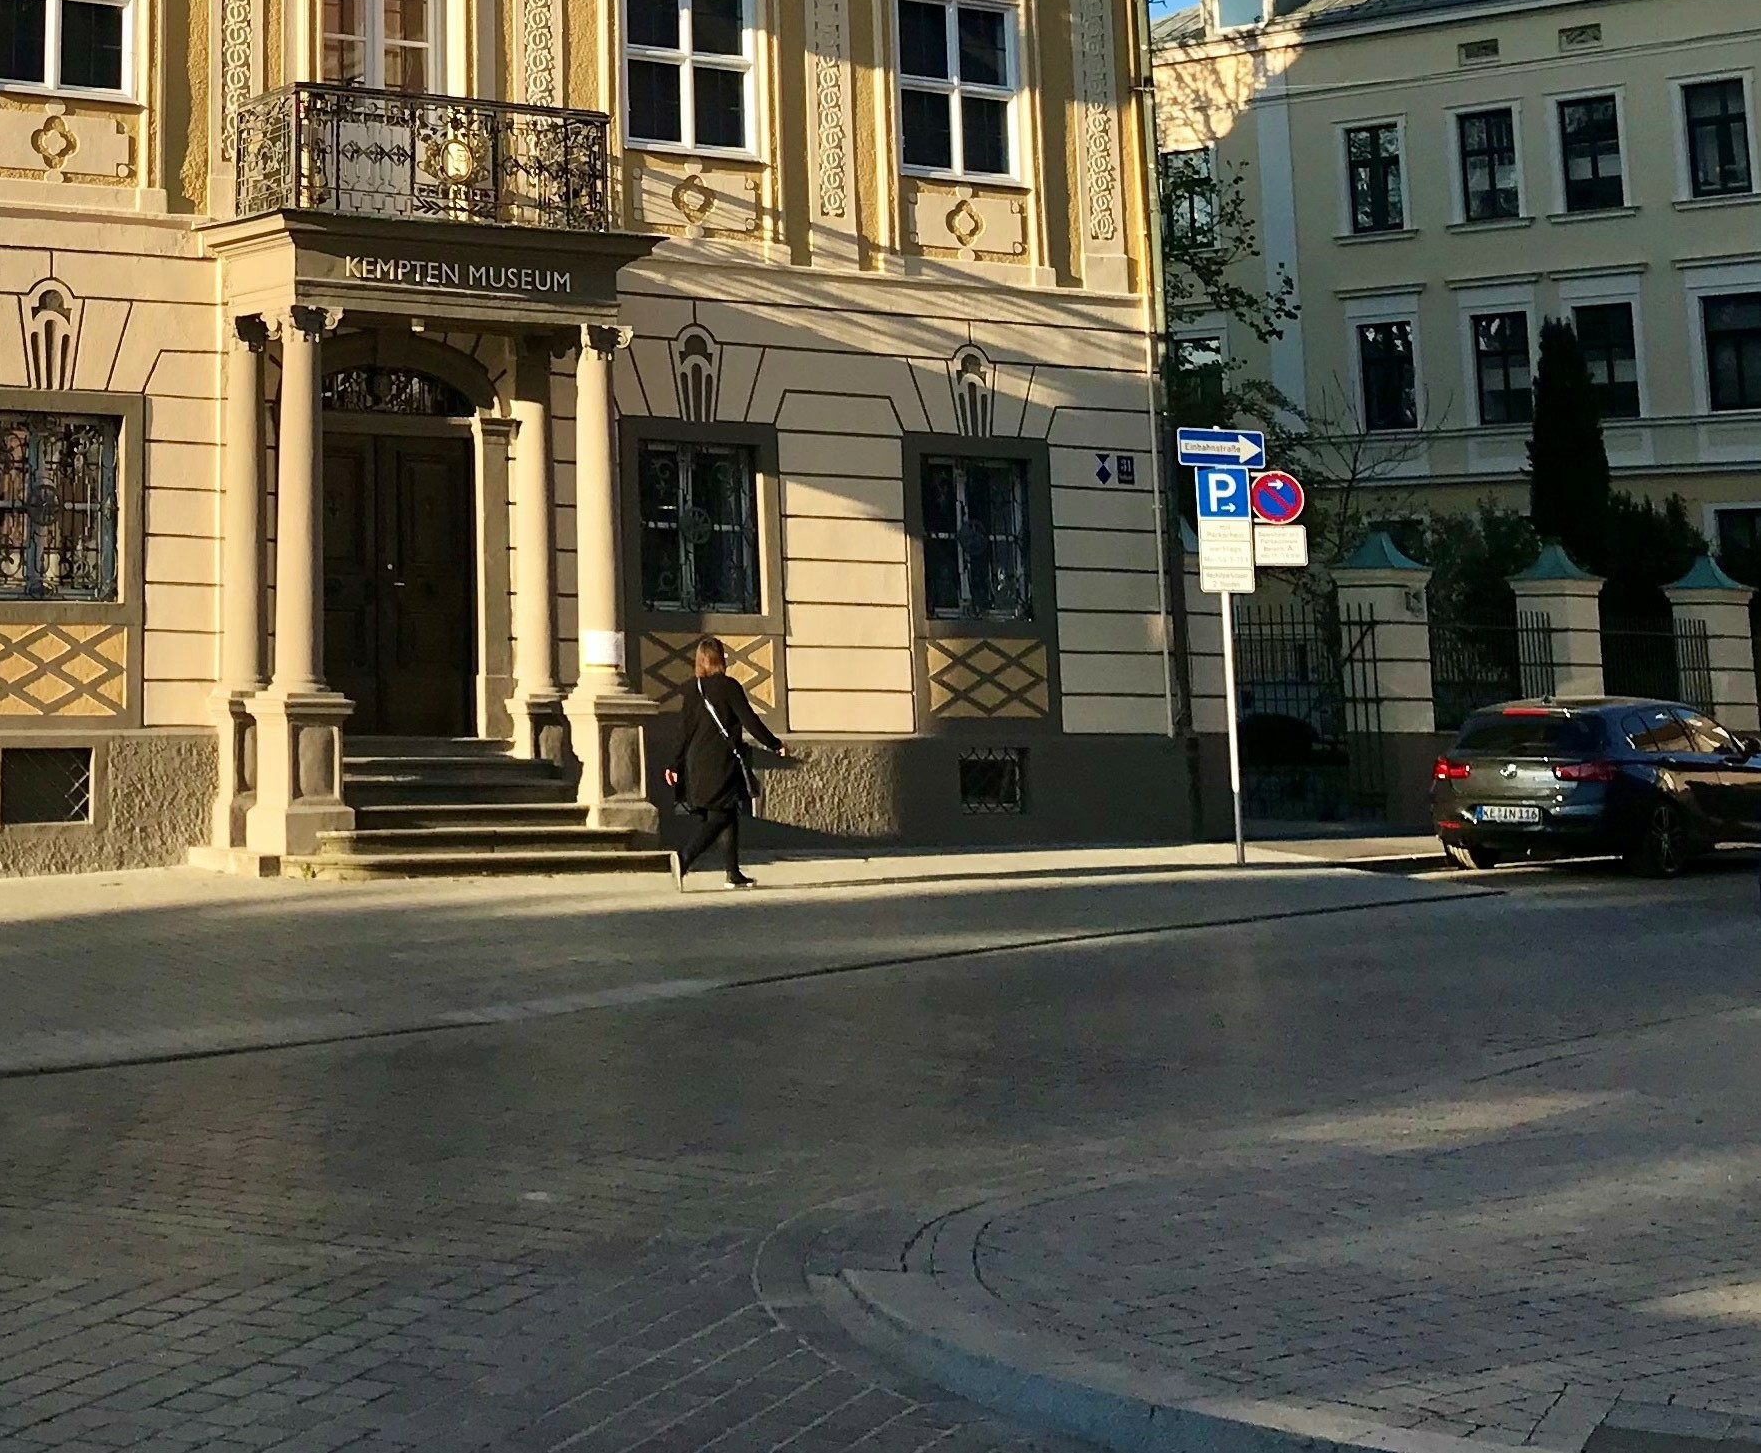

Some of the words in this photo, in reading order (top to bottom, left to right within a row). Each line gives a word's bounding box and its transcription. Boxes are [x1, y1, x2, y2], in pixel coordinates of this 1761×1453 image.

[345, 255, 460, 284] KEMPTEN
[468, 264, 572, 293] MUSEUM
[1184, 442, 1242, 454] Einbahnstraße
[1208, 473, 1237, 512] P
